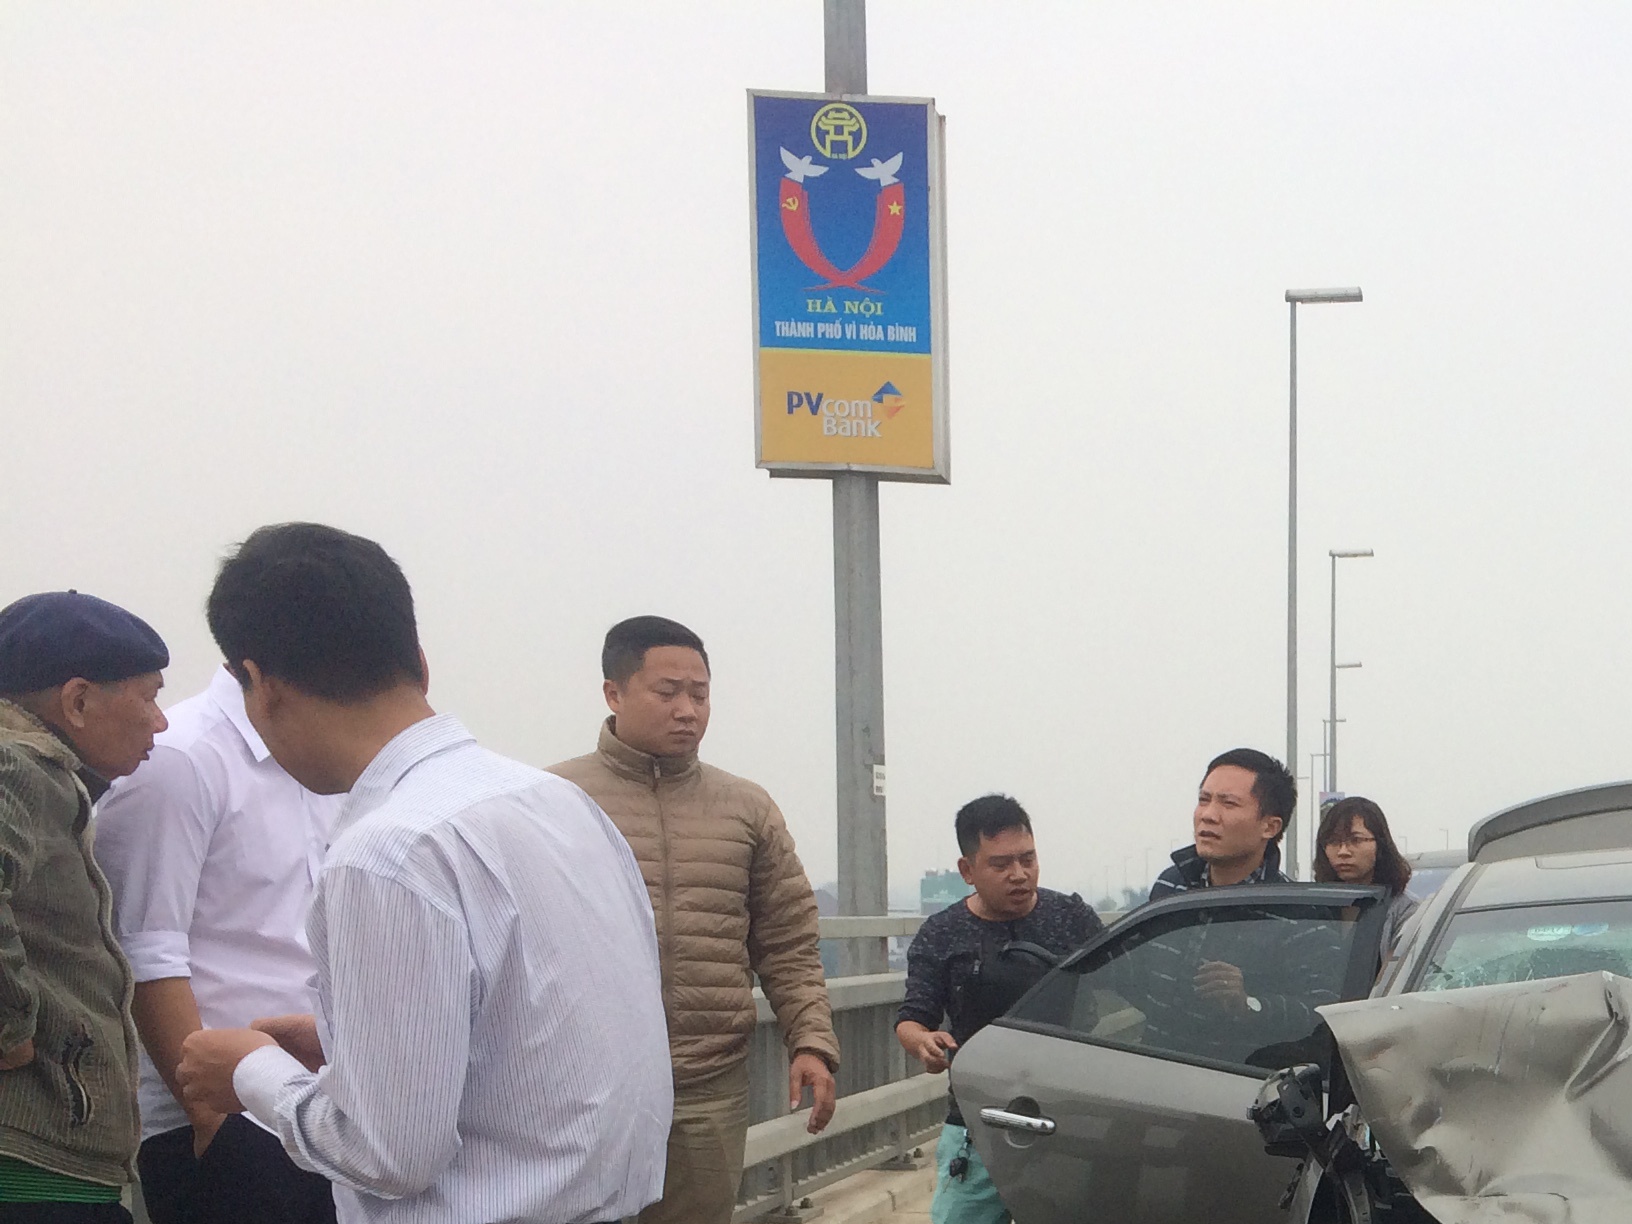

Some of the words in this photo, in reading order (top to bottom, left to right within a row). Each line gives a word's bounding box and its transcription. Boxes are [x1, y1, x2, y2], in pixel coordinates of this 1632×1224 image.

[806, 296, 838, 313] HÀ
[844, 297, 884, 318] NỘI
[774, 318, 814, 338] THÀNH
[817, 317, 842, 339] PHỐ
[845, 320, 857, 340] VÌ
[859, 321, 885, 341] HÒA
[887, 322, 917, 342] BÌNH
[823, 416, 882, 438] Bank
